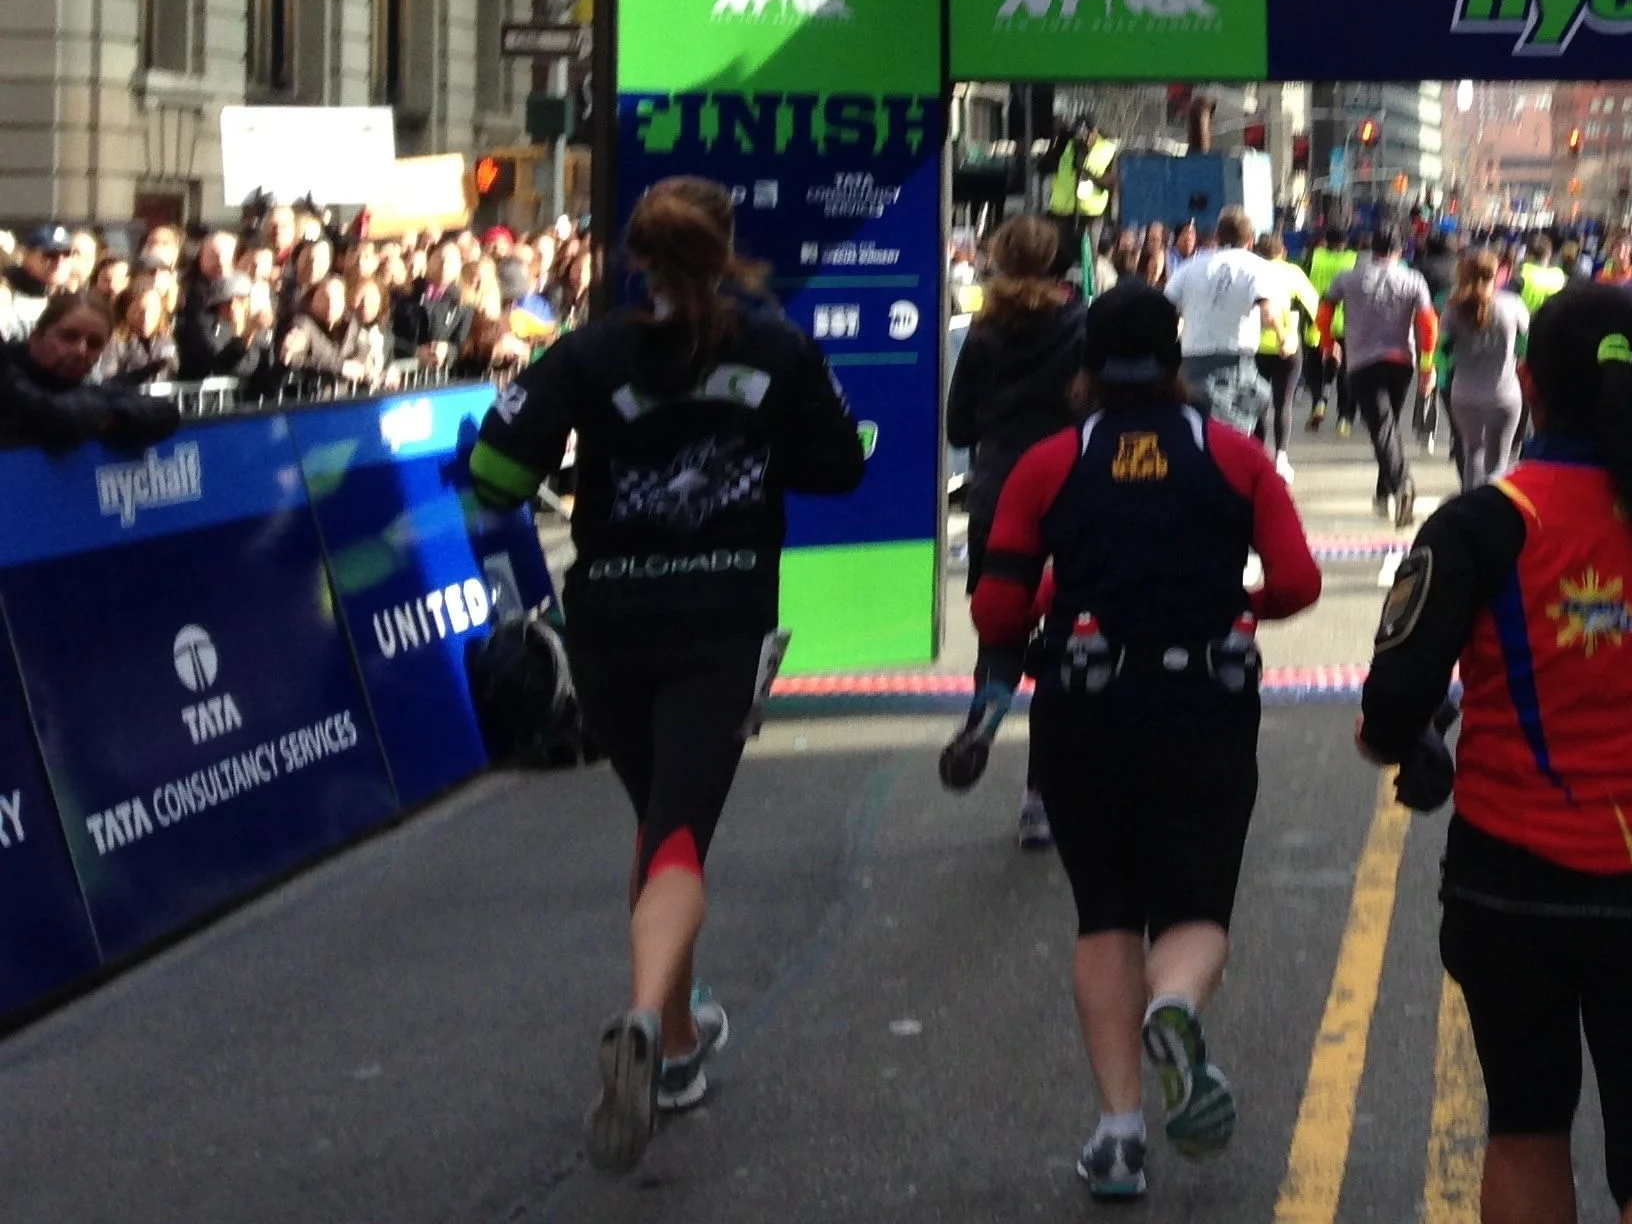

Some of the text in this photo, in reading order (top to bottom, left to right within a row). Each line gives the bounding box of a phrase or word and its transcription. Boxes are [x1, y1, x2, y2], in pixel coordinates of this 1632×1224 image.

[622, 90, 938, 156] FINISH
[372, 577, 490, 660] UNITED
[181, 692, 242, 746] TATA
[85, 709, 358, 857] TATA CONSULTANCY SERVICES
